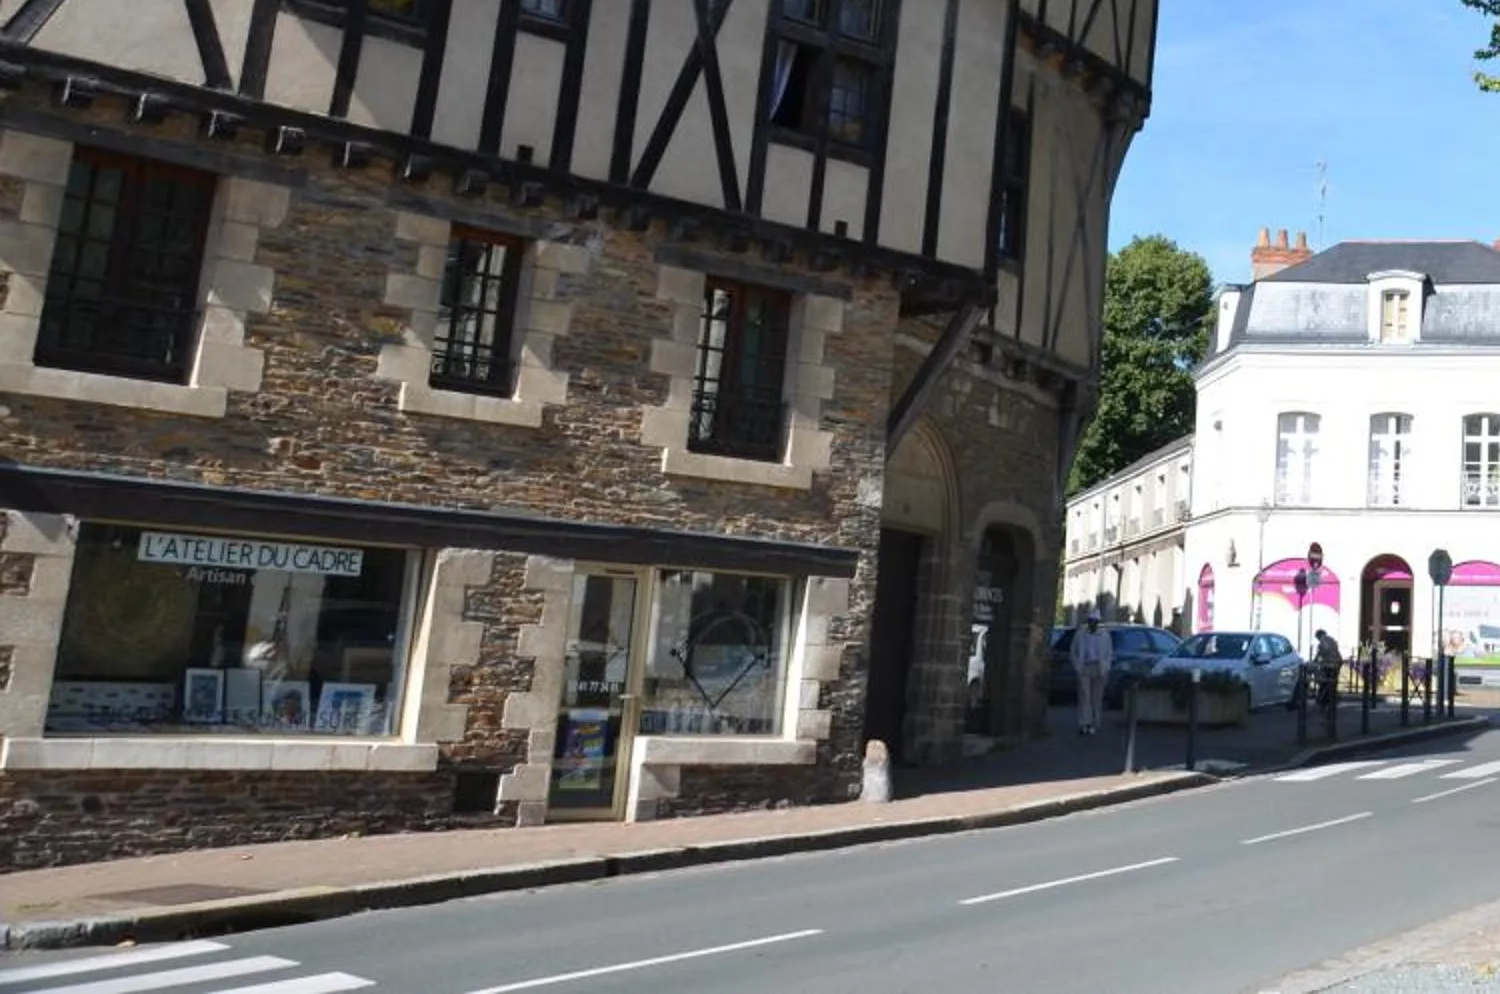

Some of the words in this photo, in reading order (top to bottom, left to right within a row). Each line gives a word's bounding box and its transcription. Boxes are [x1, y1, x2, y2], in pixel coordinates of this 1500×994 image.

[144, 536, 252, 566] L'ATELIER
[257, 545, 290, 569] DU
[293, 547, 361, 573] CADRE
[184, 566, 247, 585] Artisan
